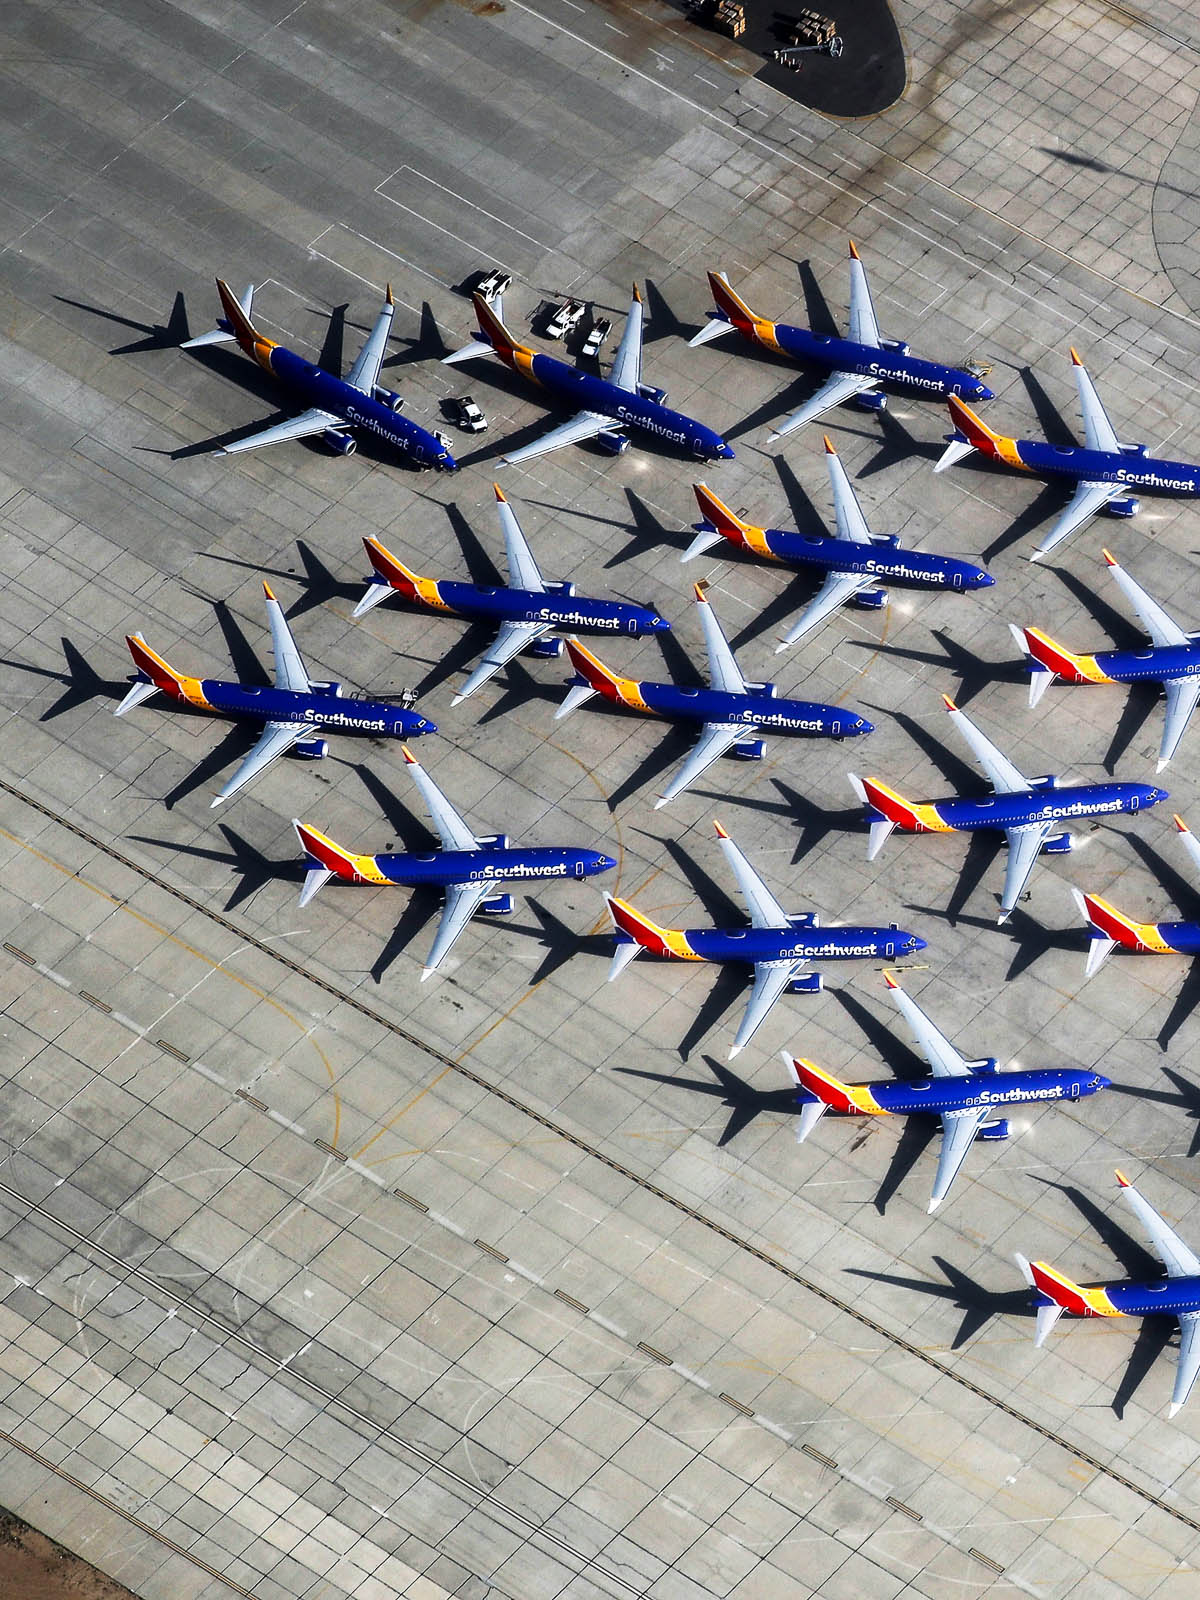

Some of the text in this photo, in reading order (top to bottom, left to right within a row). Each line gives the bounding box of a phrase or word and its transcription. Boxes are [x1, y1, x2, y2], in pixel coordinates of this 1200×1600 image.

[870, 363, 944, 392] Southwest
[347, 406, 409, 450] Southwest
[617, 406, 686, 444] Southwest
[1117, 469, 1195, 491] Southwest
[866, 560, 945, 583] Southwest
[541, 607, 619, 629] Southwest
[305, 710, 385, 730] Southwest
[743, 710, 823, 731] Southwest
[1043, 799, 1123, 818] Southwest
[484, 864, 566, 877] Southwest
[794, 943, 877, 956] Southwest
[980, 1085, 1063, 1103] Southwest
